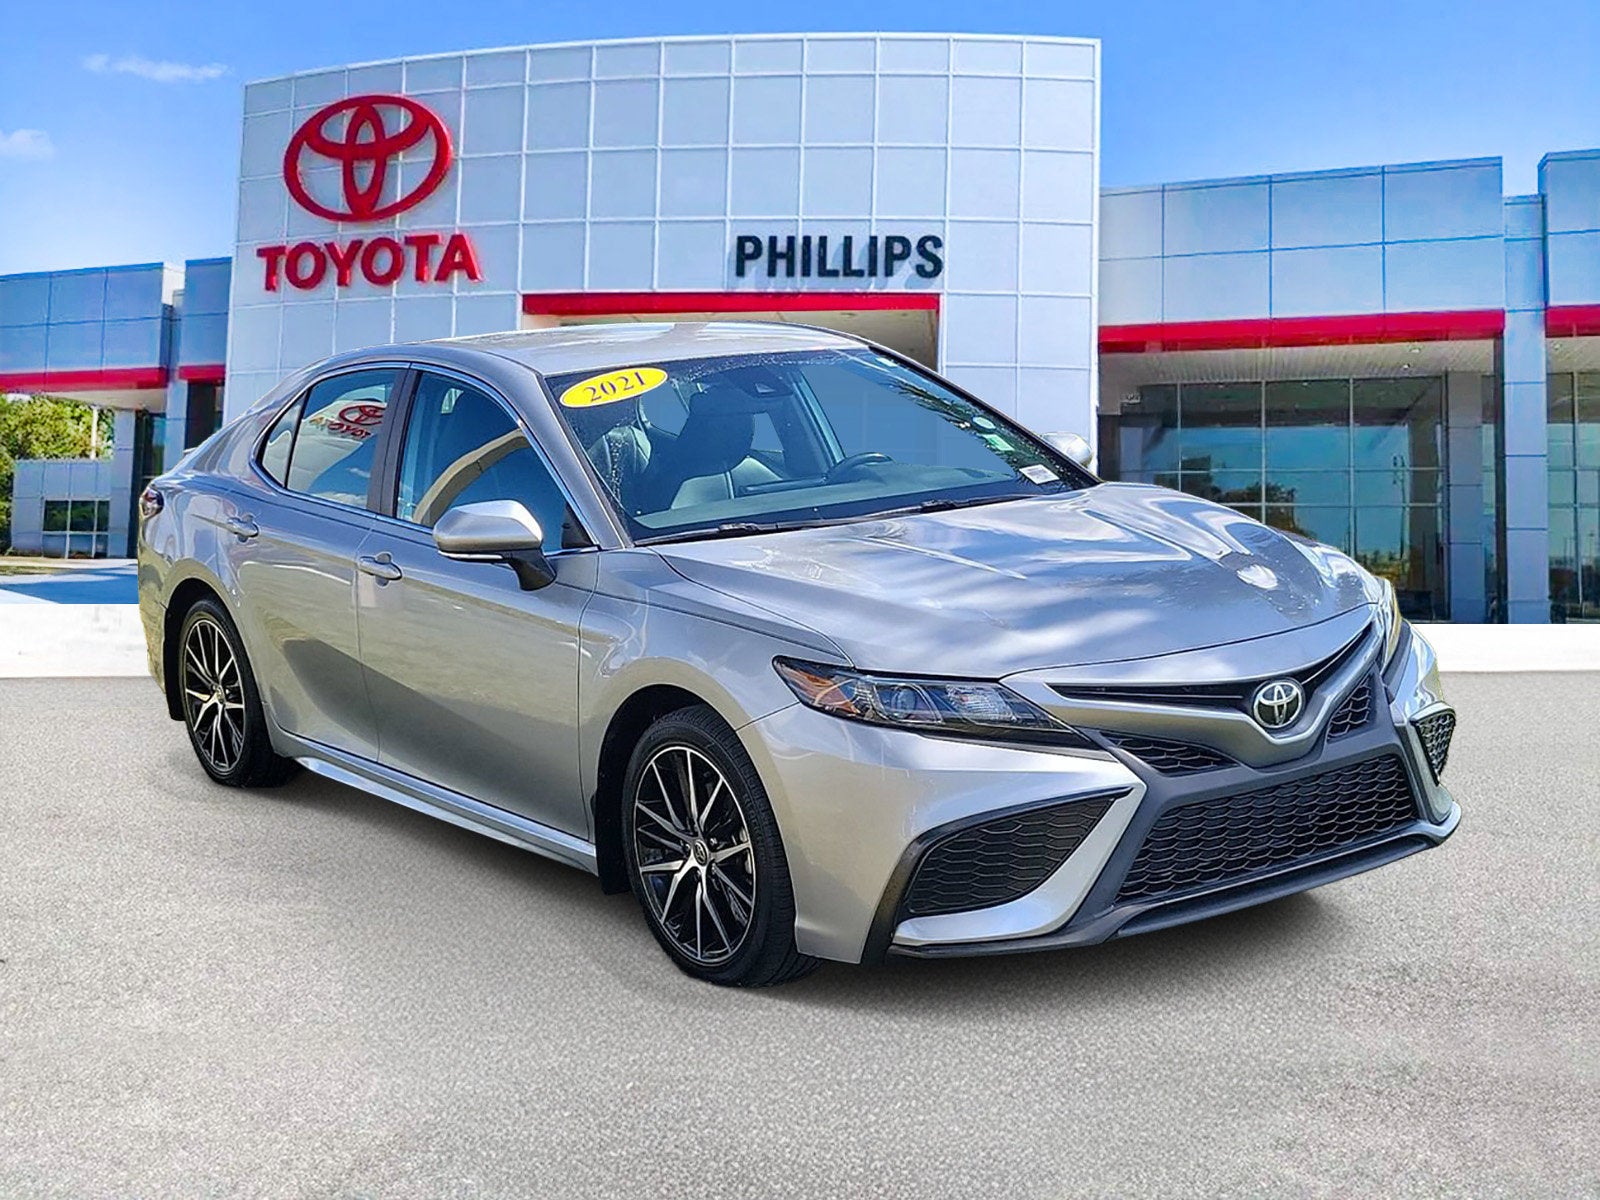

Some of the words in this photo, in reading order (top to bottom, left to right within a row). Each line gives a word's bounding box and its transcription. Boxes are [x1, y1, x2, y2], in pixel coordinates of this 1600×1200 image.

[256, 234, 482, 292] TOYOTA
[735, 235, 944, 279] PHILLIPS
[584, 371, 645, 402] 2021
